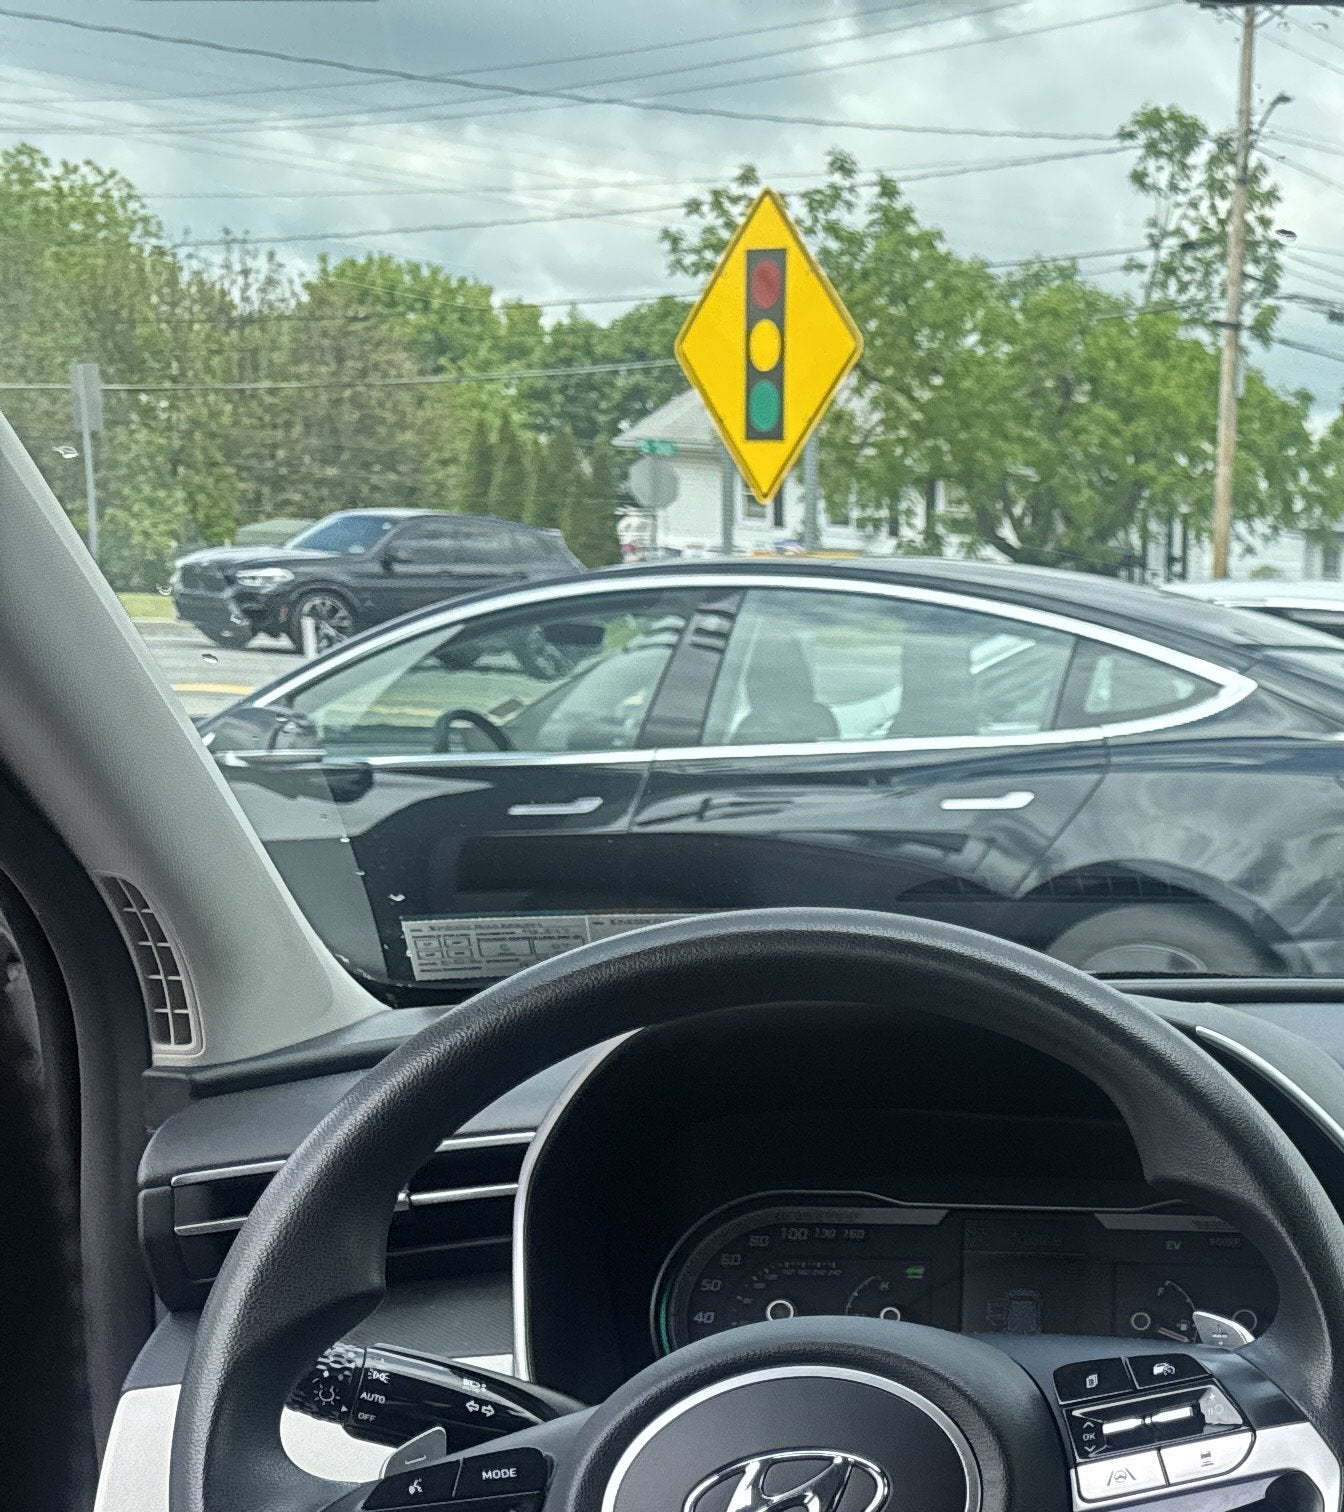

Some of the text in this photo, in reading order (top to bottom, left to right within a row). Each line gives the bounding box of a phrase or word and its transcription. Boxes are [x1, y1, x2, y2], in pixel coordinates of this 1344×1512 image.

[1165, 1240, 1182, 1251] EV
[700, 1279, 722, 1292] 50
[693, 1312, 715, 1324] 40
[360, 1391, 386, 1404] AUTO
[357, 1412, 377, 1422] OFF
[1083, 1433, 1096, 1441] OK
[482, 1467, 518, 1480] MODE
